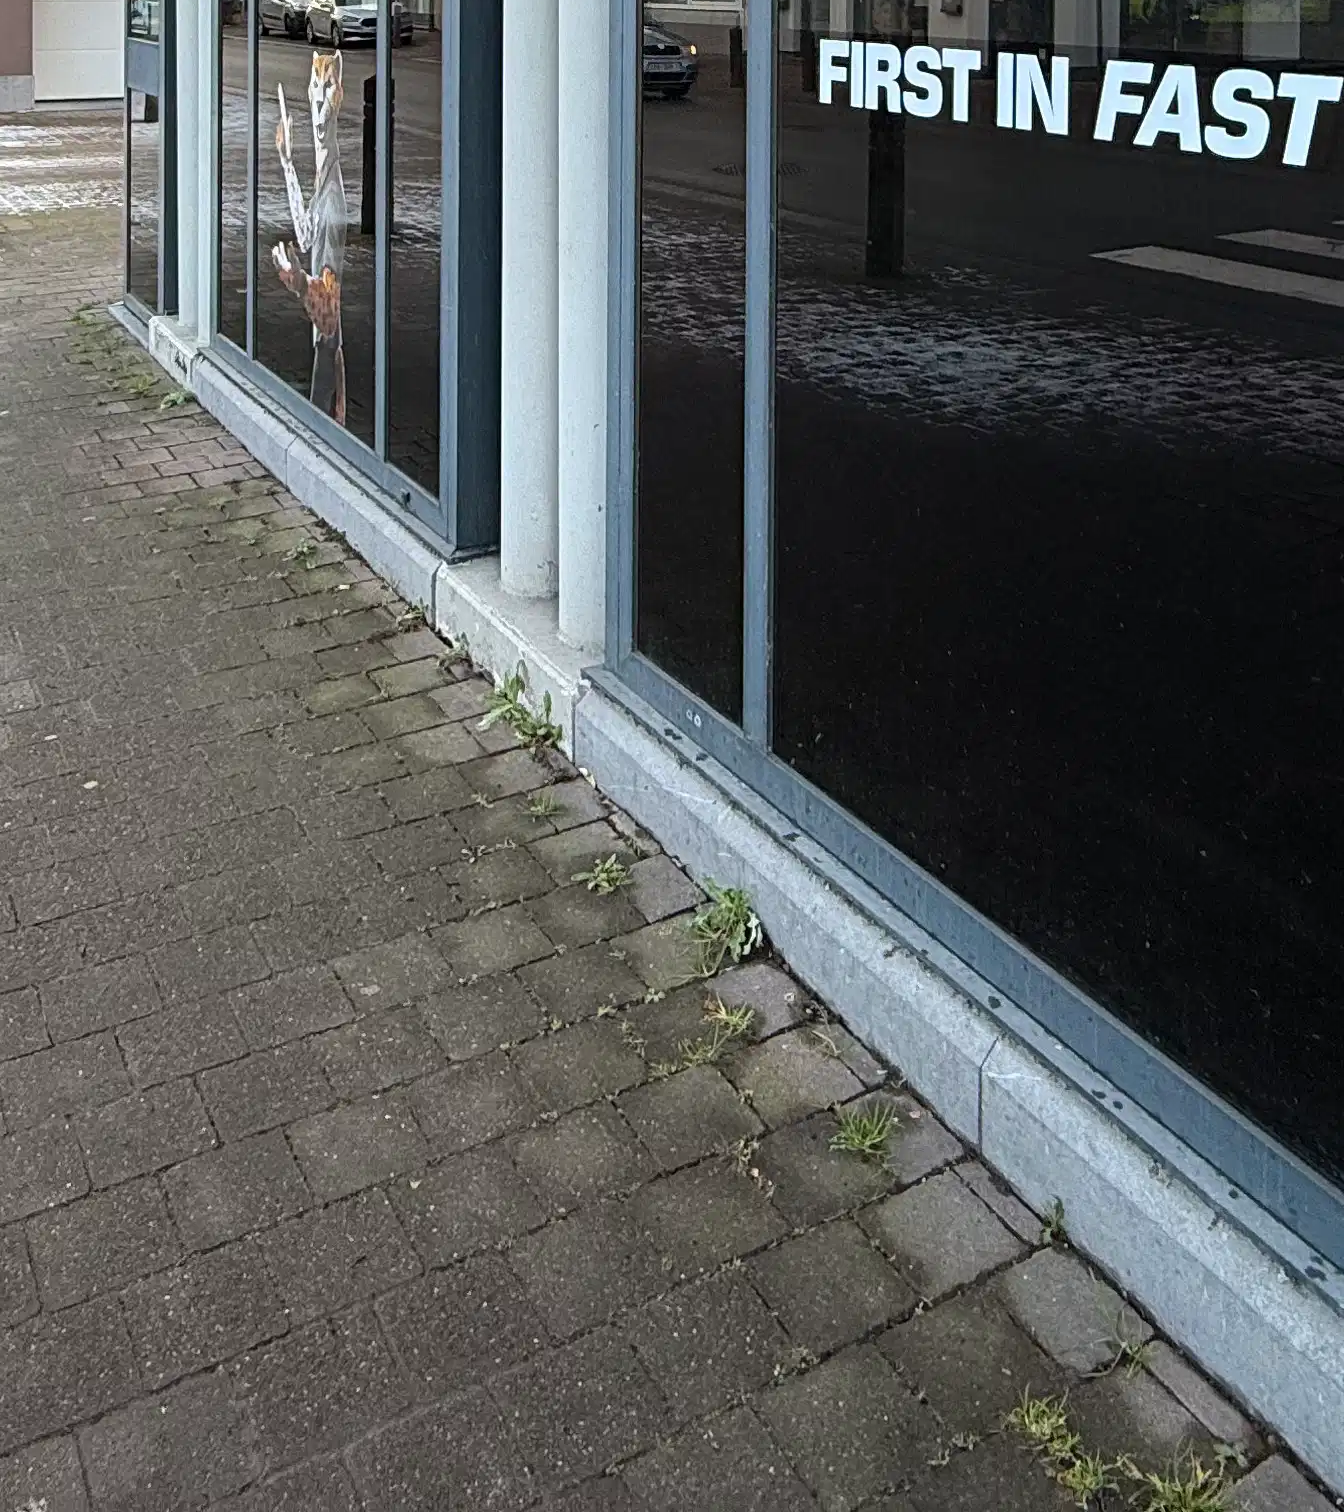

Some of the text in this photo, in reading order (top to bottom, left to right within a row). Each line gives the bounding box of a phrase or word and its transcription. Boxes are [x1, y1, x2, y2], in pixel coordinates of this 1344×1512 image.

[818, 38, 1344, 166] FIRST IN FAST
